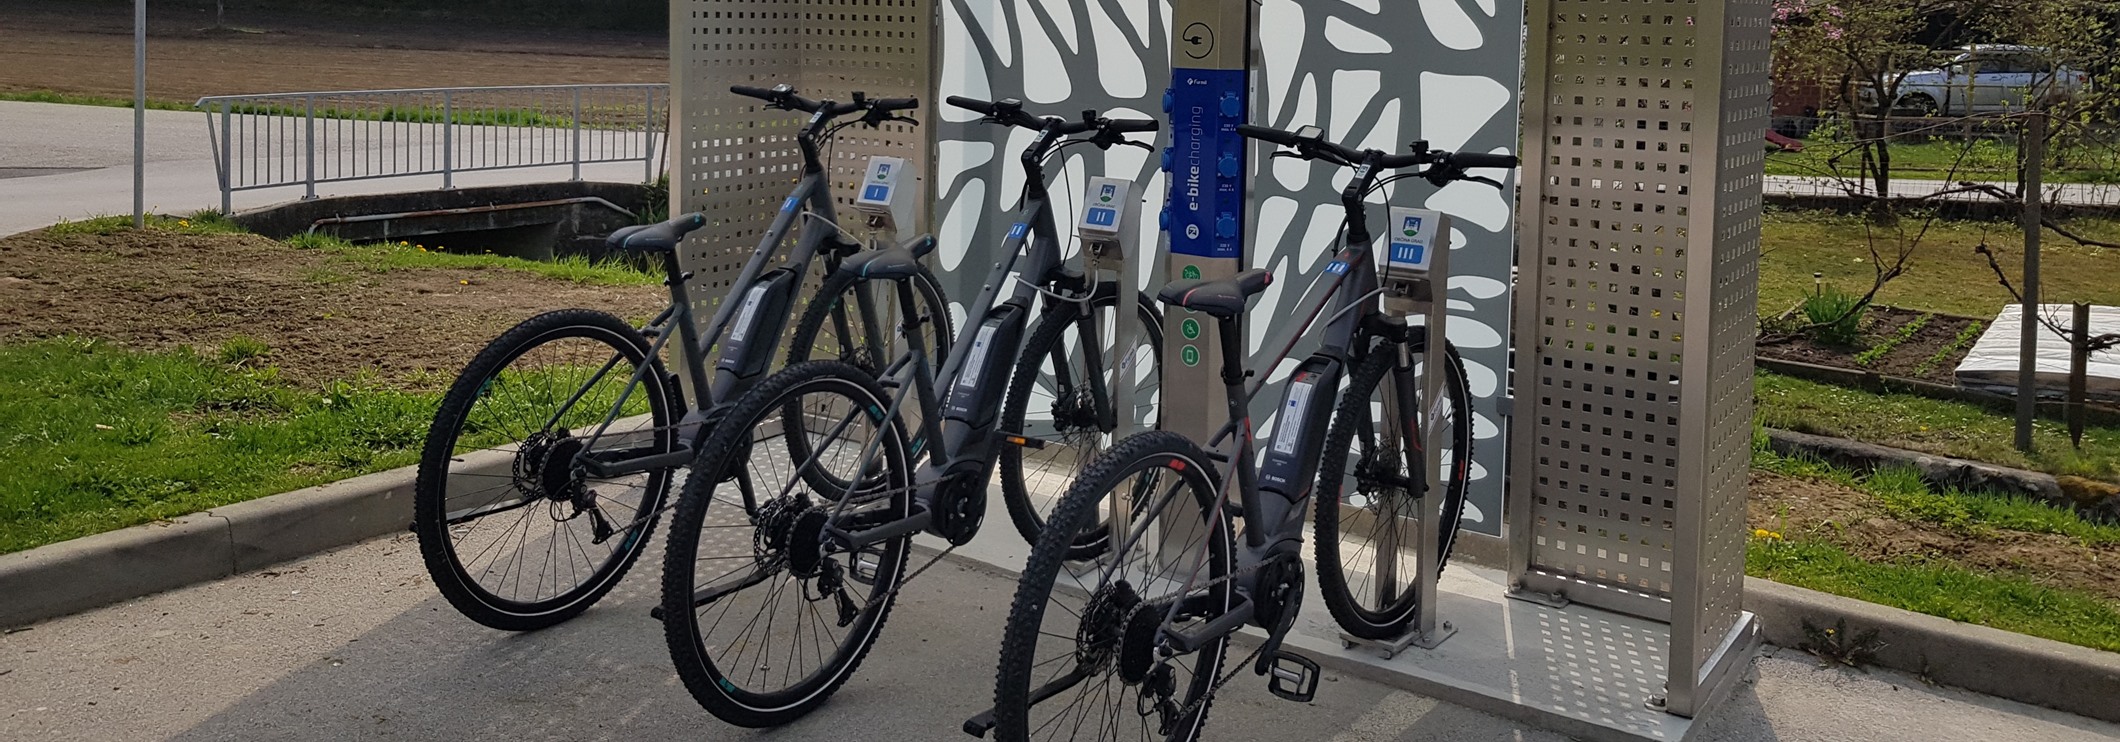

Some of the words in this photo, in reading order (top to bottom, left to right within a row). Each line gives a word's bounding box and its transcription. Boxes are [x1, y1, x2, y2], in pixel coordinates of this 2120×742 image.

[1187, 106, 1204, 211] e-bikecharging
[1096, 211, 1106, 222] II
[1398, 247, 1414, 260] III
[1326, 263, 1346, 272] III
